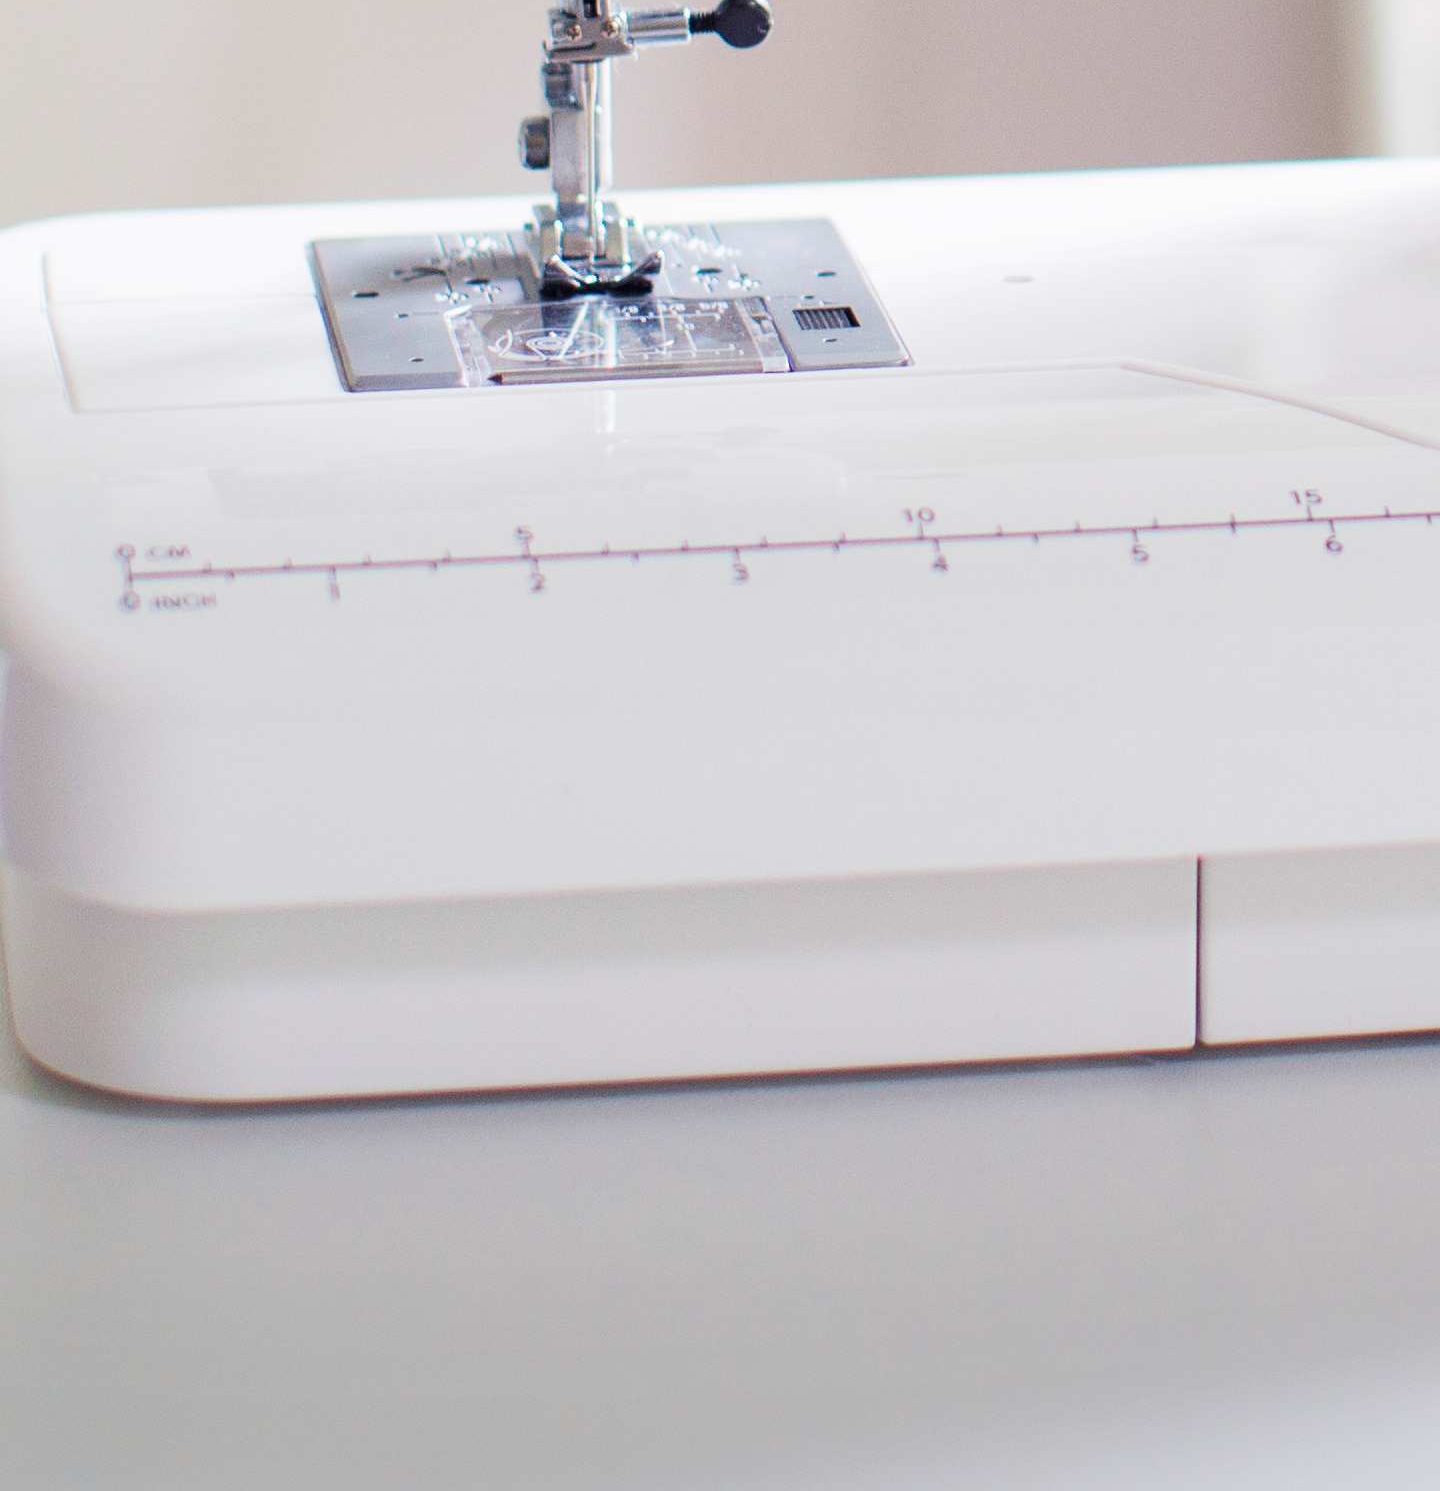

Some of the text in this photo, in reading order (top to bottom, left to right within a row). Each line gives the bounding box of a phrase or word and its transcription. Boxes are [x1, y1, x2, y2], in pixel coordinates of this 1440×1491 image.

[904, 507, 936, 524] 10
[1291, 489, 1324, 506] 15
[1131, 543, 1150, 563] 5
[1324, 535, 1343, 555] 6
